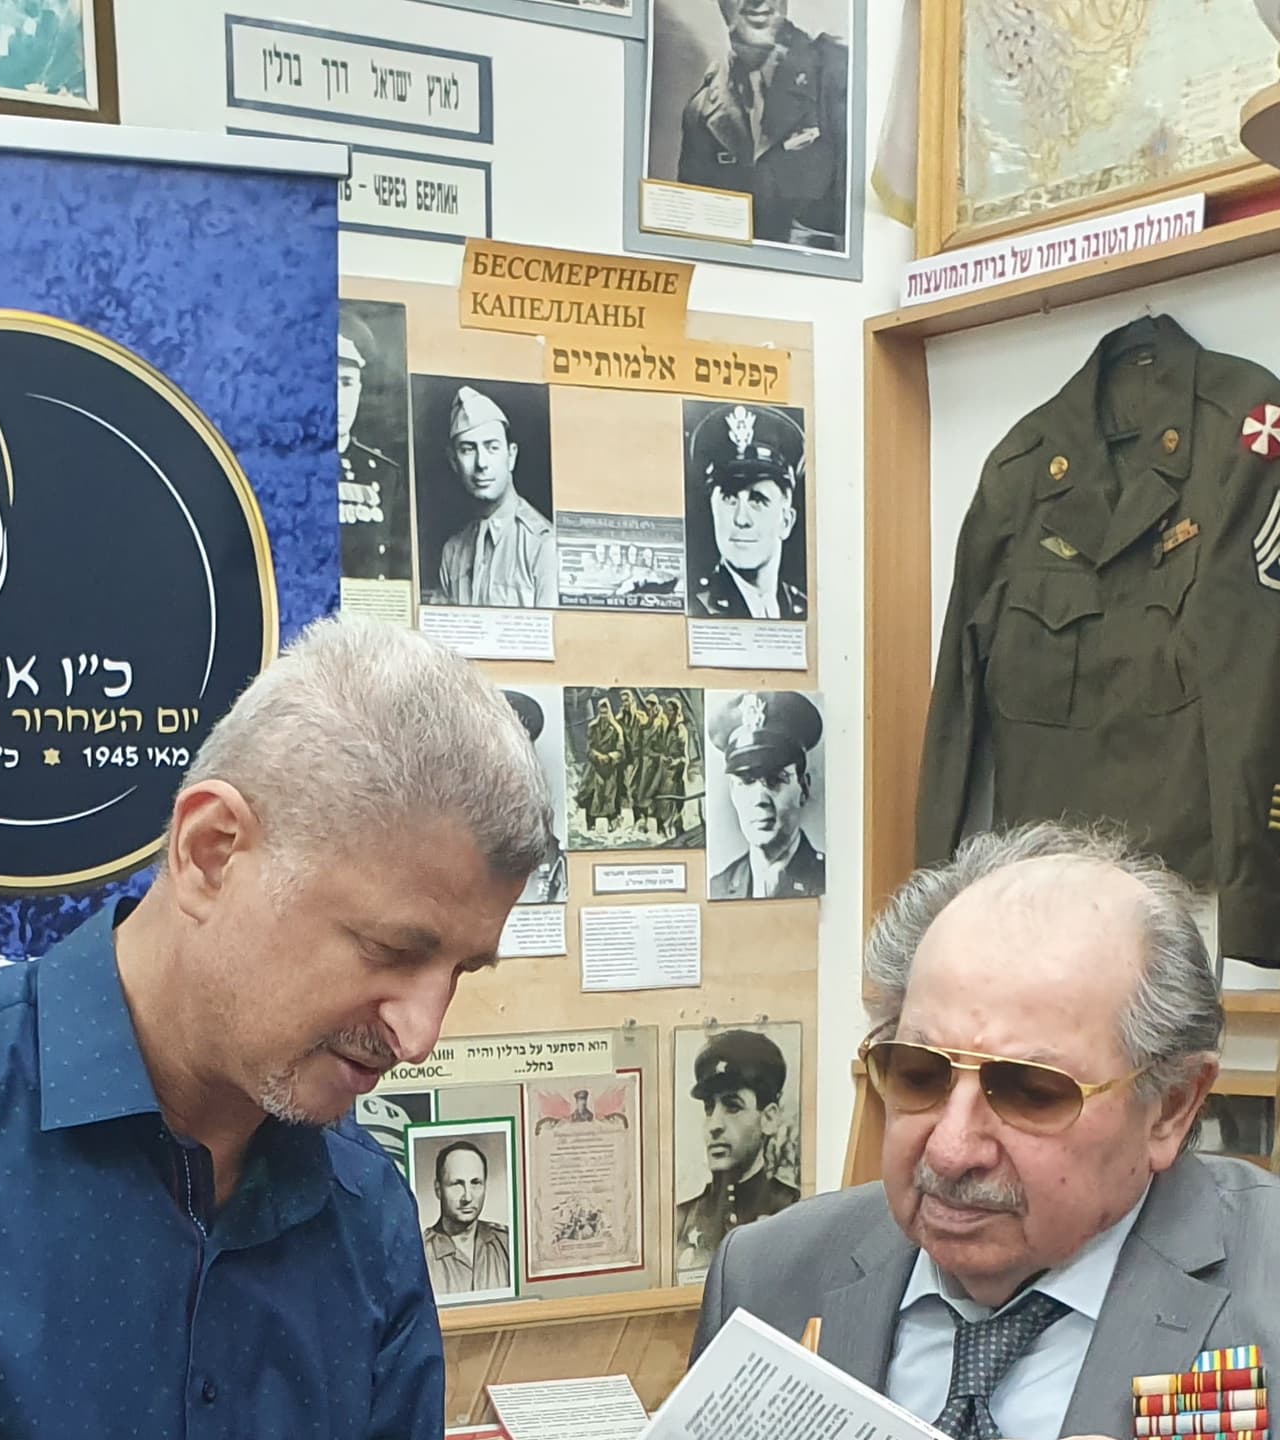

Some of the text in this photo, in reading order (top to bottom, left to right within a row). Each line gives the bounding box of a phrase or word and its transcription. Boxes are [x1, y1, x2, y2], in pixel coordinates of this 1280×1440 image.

[262, 43, 460, 116] לארץ ישראל דרך ברלין
[373, 174, 407, 209] ЧЕРЕЗ
[416, 179, 458, 215] БЕРЛИН
[471, 251, 680, 295] БЕССМЕРТНЫЕ
[972, 254, 1006, 284] ברית
[1011, 245, 1033, 274] של
[907, 261, 968, 299] המועצות
[471, 291, 646, 329] КАПЕЛЛАНЫ
[553, 344, 779, 396] קפלנים אלמותיים
[12, 706, 144, 735] השחרור
[158, 706, 200, 735] יום
[82, 745, 139, 768] 1945
[467, 1040, 609, 1059] הוא הסתער על ברלין והיה
